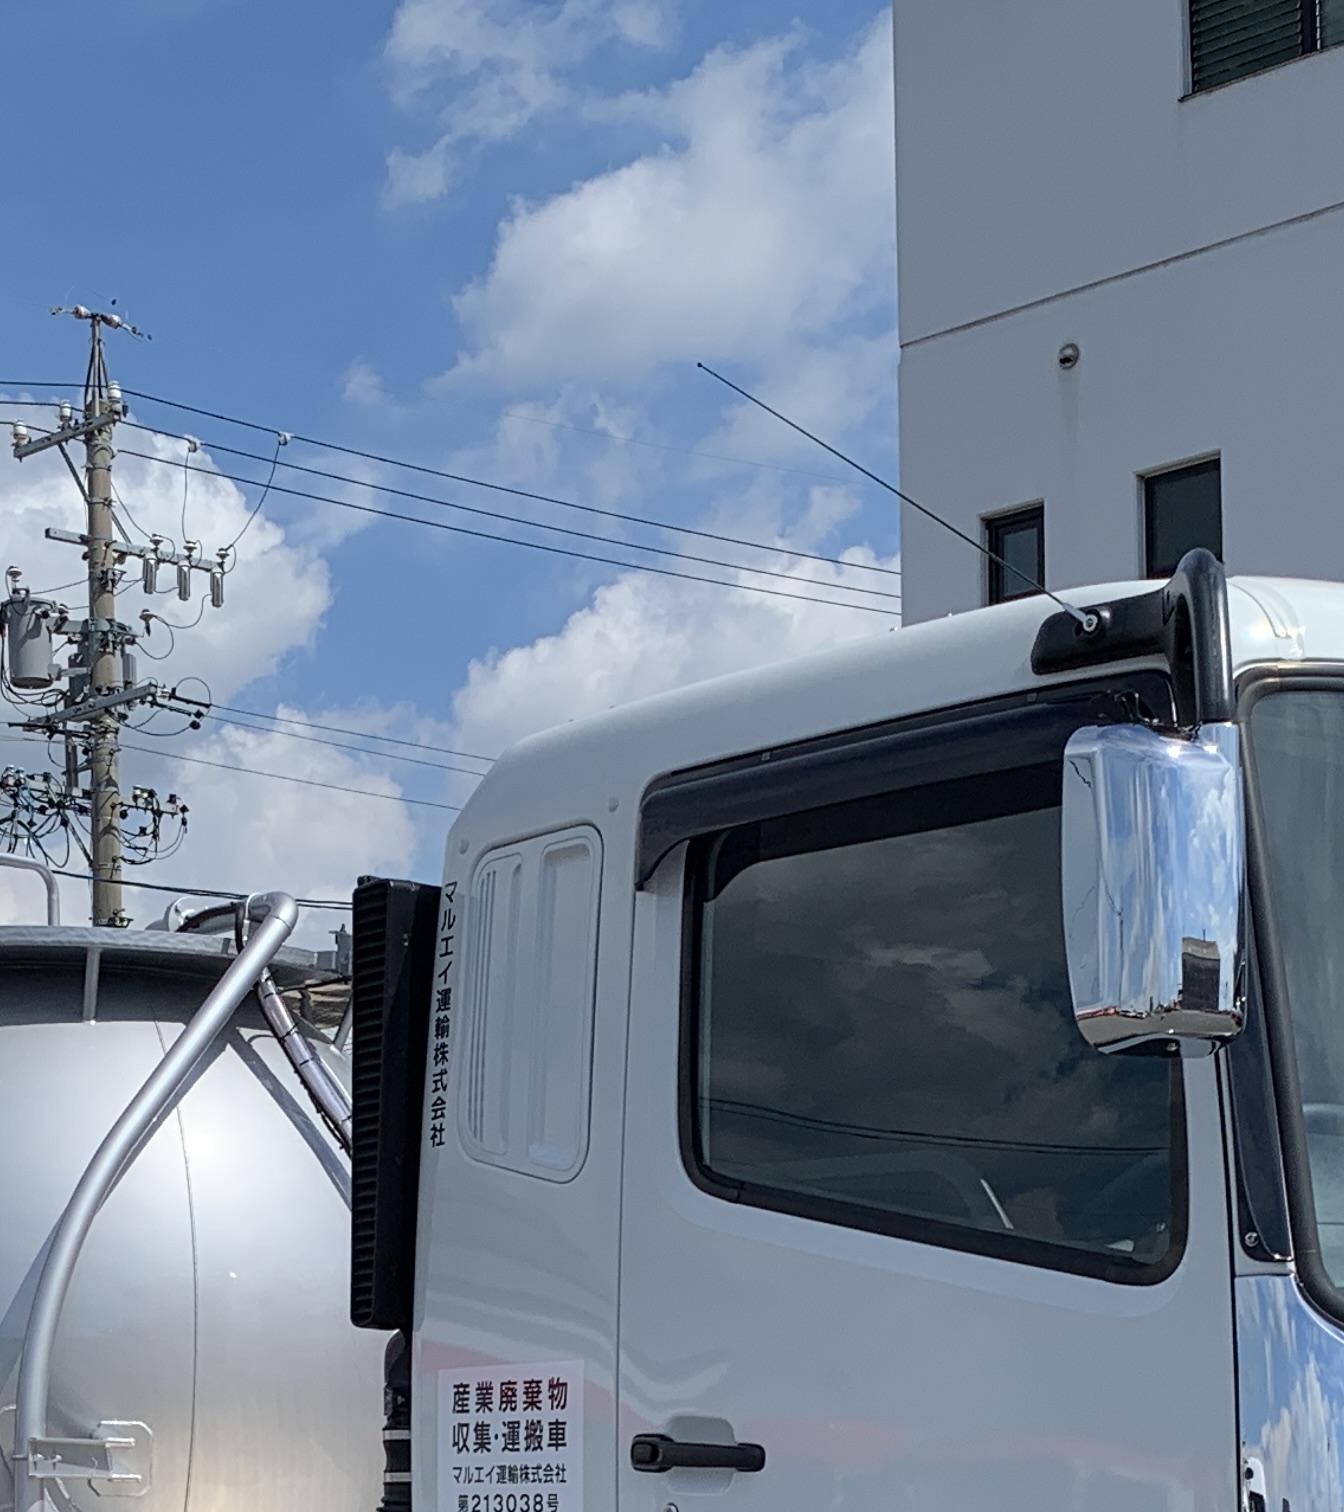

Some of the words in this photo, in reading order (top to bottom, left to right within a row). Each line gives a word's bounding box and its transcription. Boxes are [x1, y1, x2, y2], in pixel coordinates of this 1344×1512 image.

[430, 881, 458, 1148] マルエイ運輸株式会社
[452, 1376, 568, 1414] 産業廃棄物
[452, 1463, 567, 1484] マルエイ運輸株式会社
